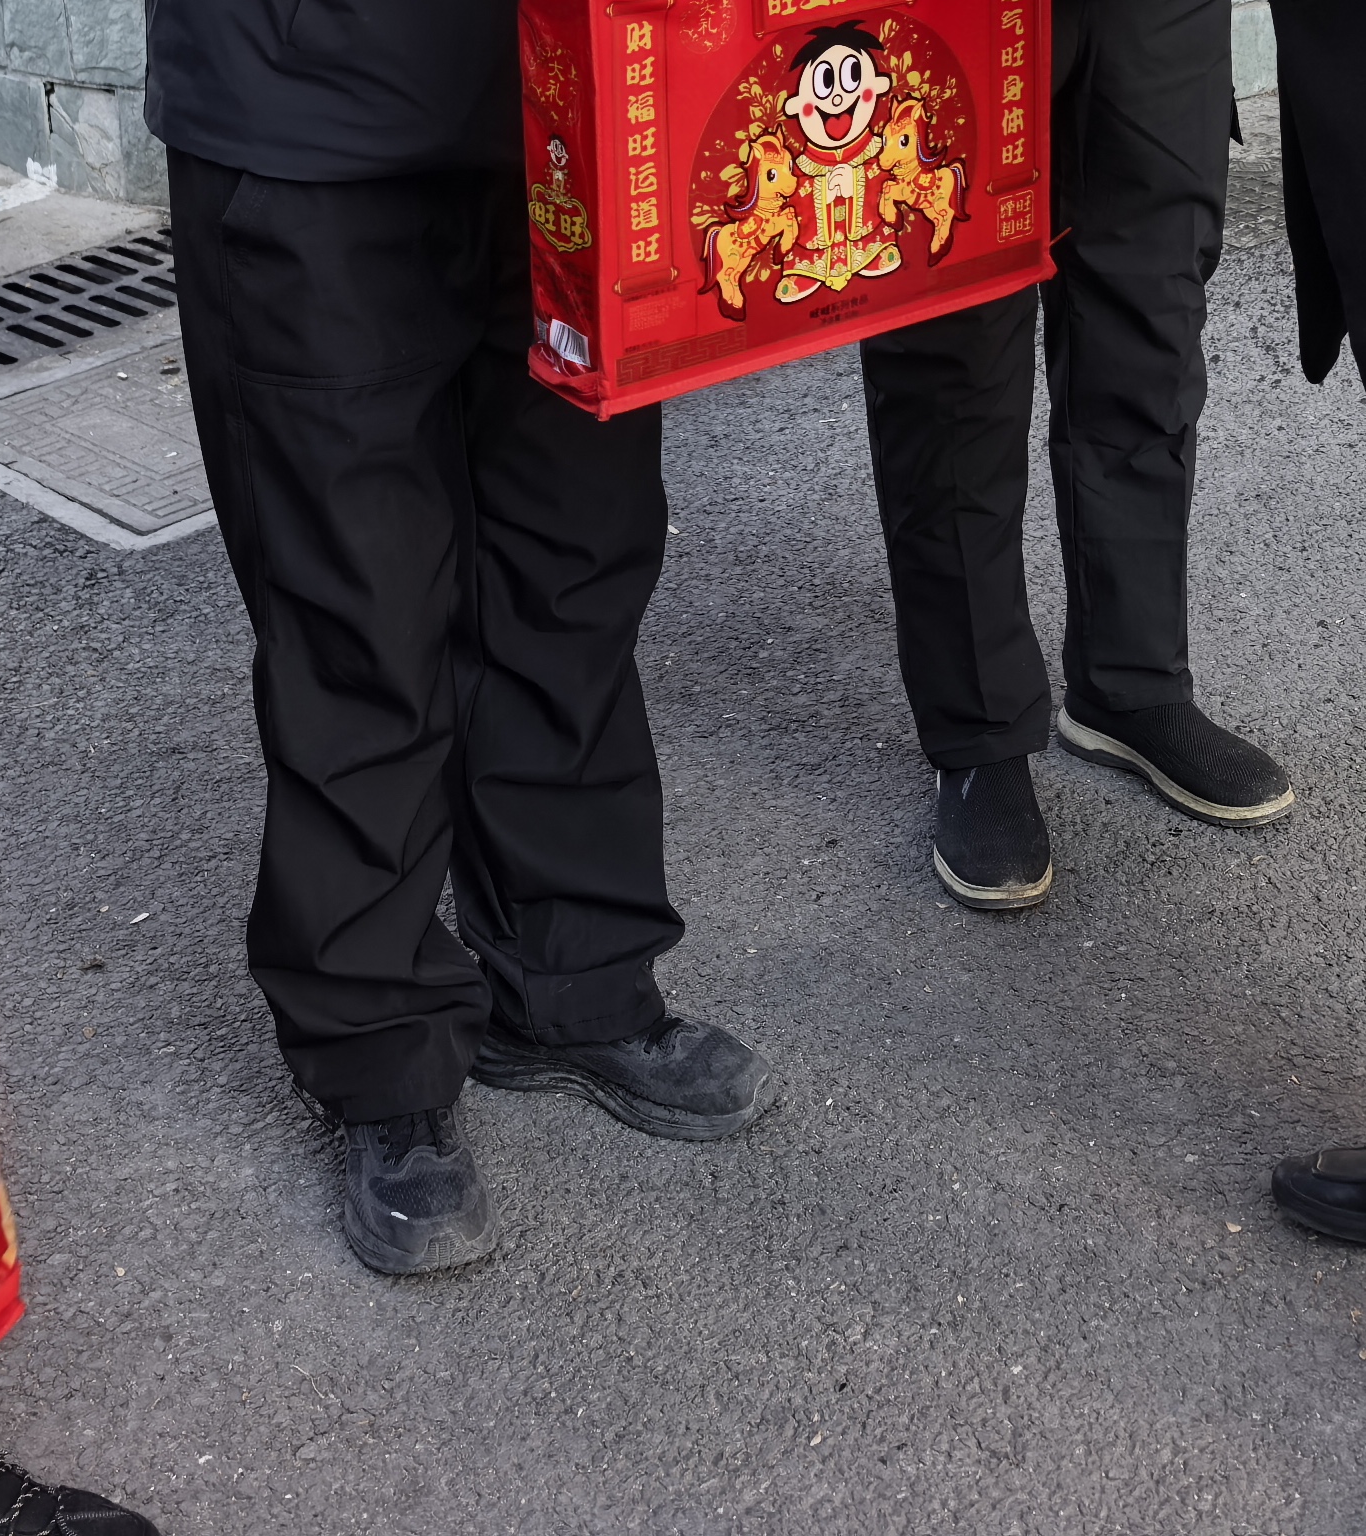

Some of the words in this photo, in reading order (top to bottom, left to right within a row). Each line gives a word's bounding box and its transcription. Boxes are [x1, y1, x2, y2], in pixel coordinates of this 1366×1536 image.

[625, 20, 661, 263] 财旺福旺运道旺
[535, 201, 584, 246] 旺旺
